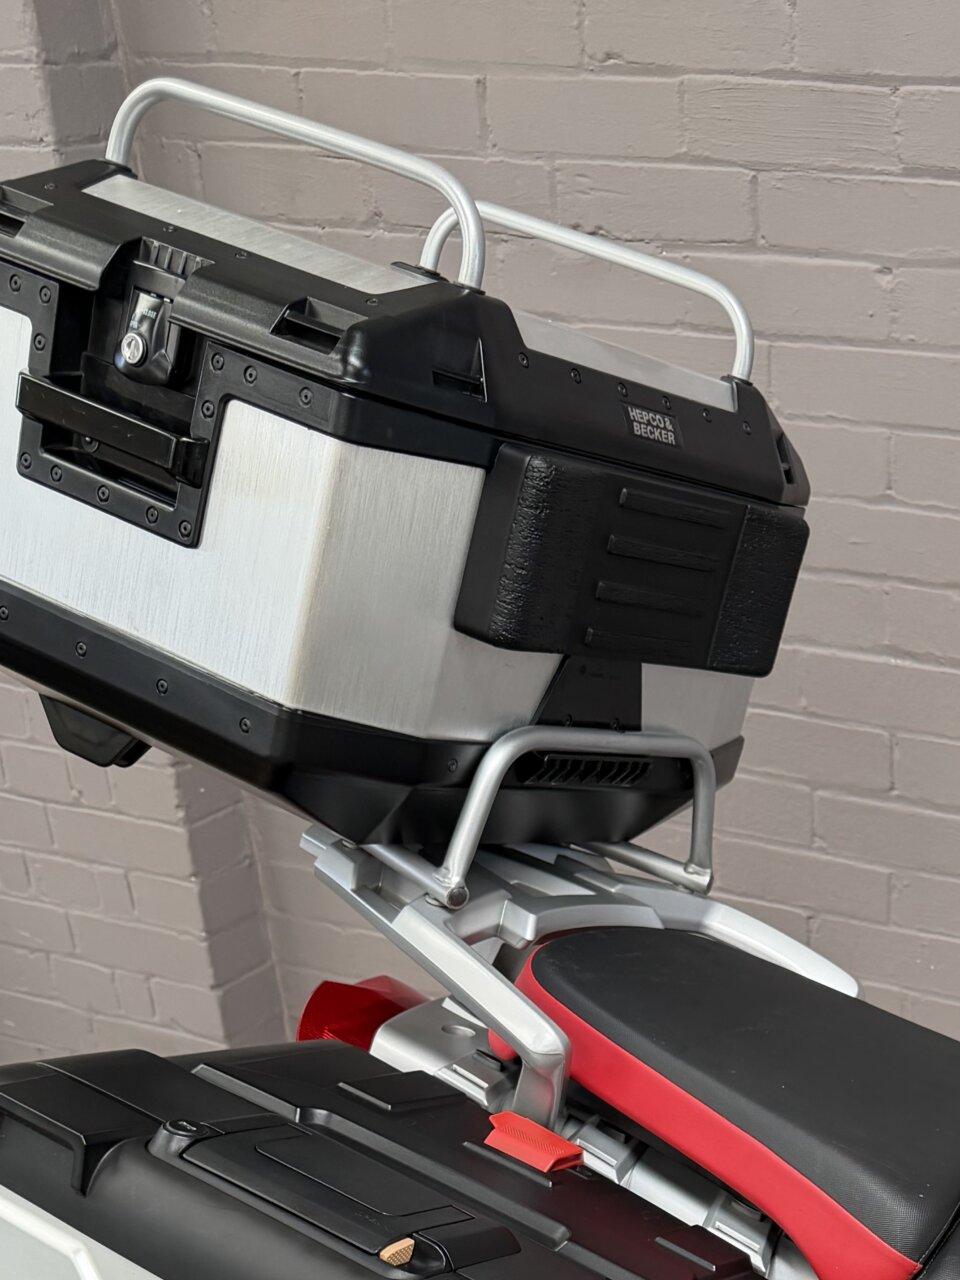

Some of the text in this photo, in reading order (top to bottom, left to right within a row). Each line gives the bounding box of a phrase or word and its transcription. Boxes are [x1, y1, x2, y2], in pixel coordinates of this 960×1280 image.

[628, 406, 674, 431] HEPCO &
[633, 421, 676, 445] BECKER
